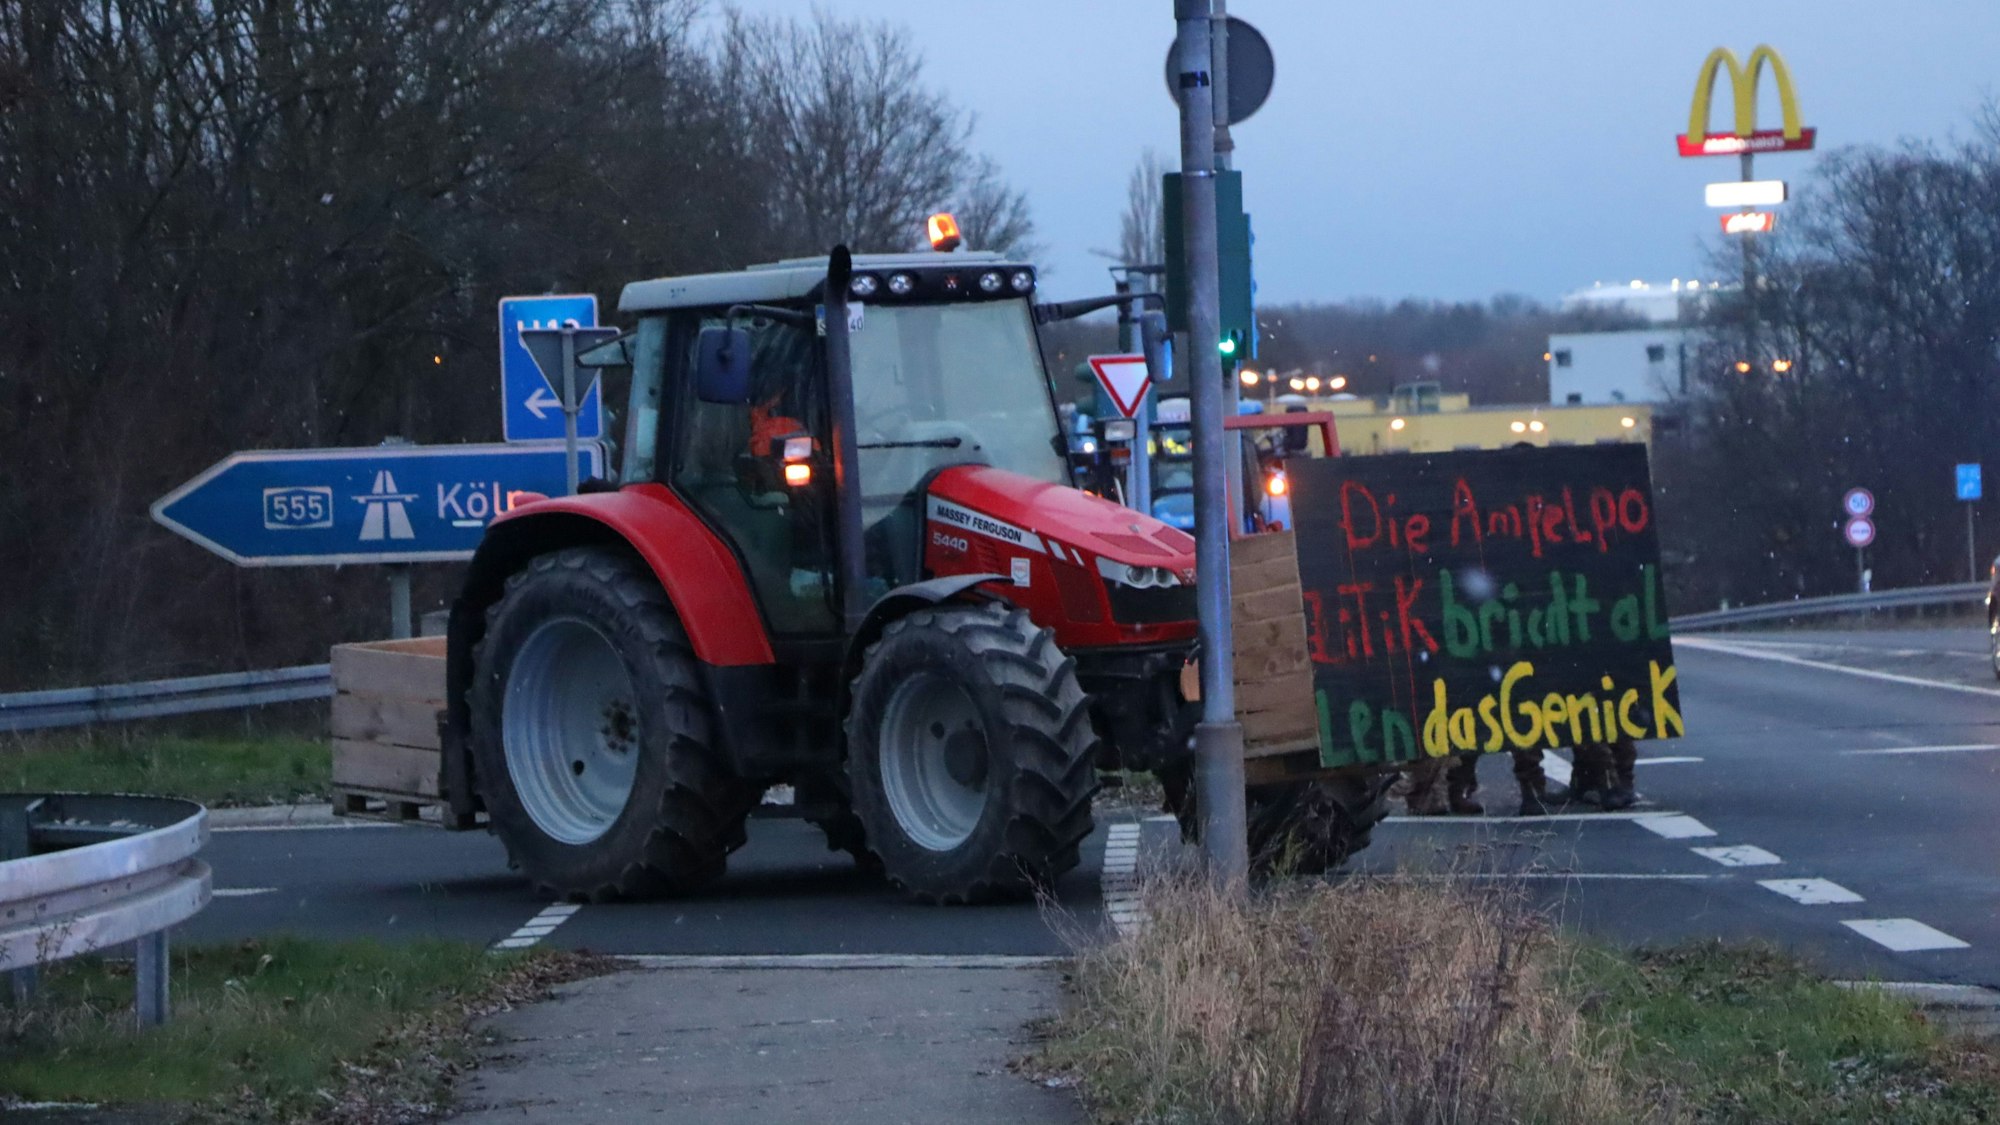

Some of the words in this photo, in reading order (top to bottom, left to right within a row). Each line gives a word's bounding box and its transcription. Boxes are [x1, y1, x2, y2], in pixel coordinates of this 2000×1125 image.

[273, 495, 323, 521] 555
[937, 505, 971, 525] MASSEY
[972, 516, 1022, 543] FERGUSON
[1339, 480, 1430, 552] Die
[932, 532, 968, 553] 5440
